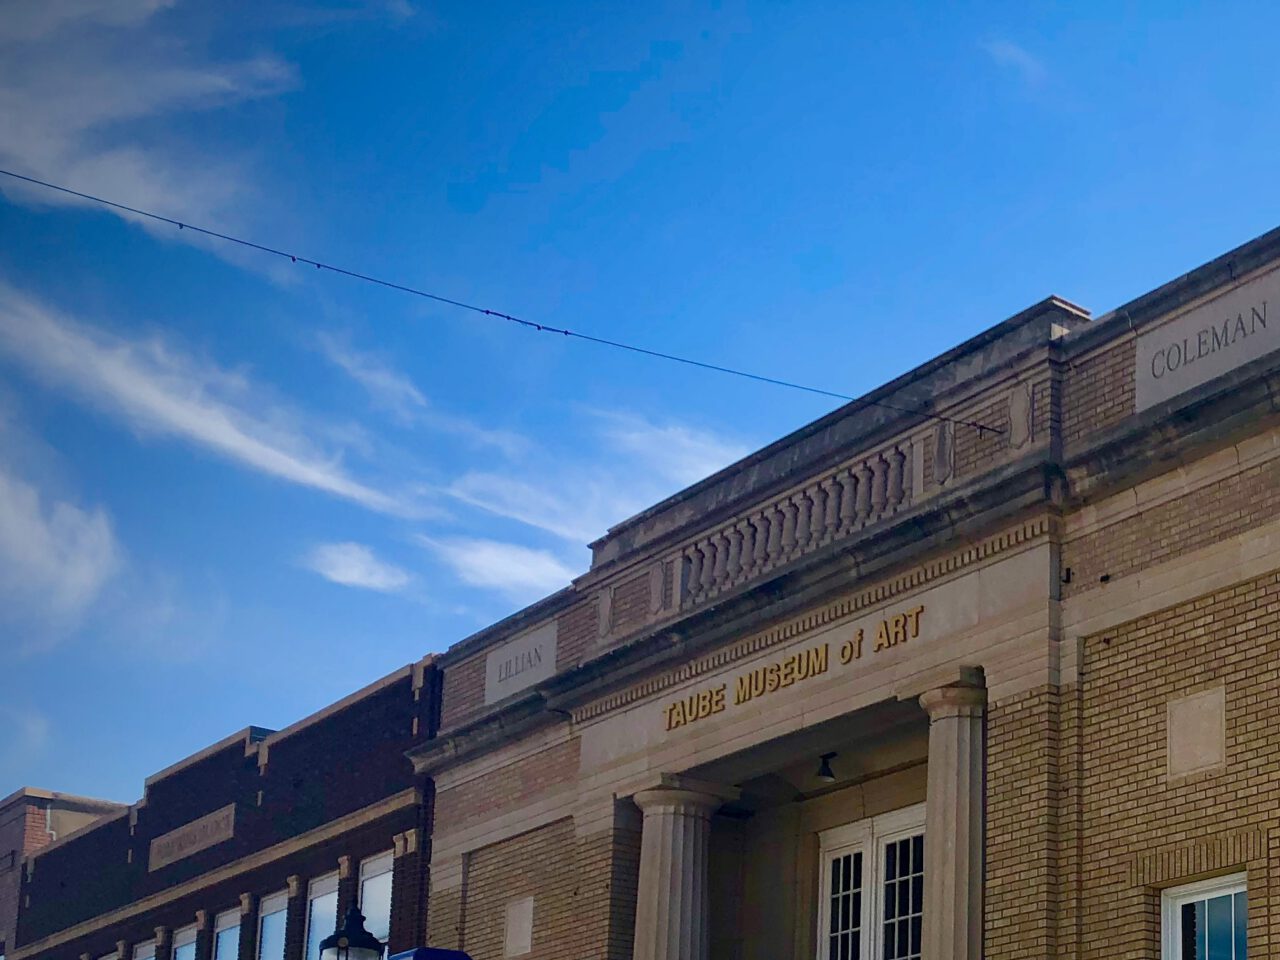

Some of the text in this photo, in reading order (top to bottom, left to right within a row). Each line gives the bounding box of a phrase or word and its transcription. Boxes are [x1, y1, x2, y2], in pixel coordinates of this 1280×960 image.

[1151, 301, 1269, 379] COLEMAN
[663, 604, 925, 731] TAUBE MUSEUM of ART
